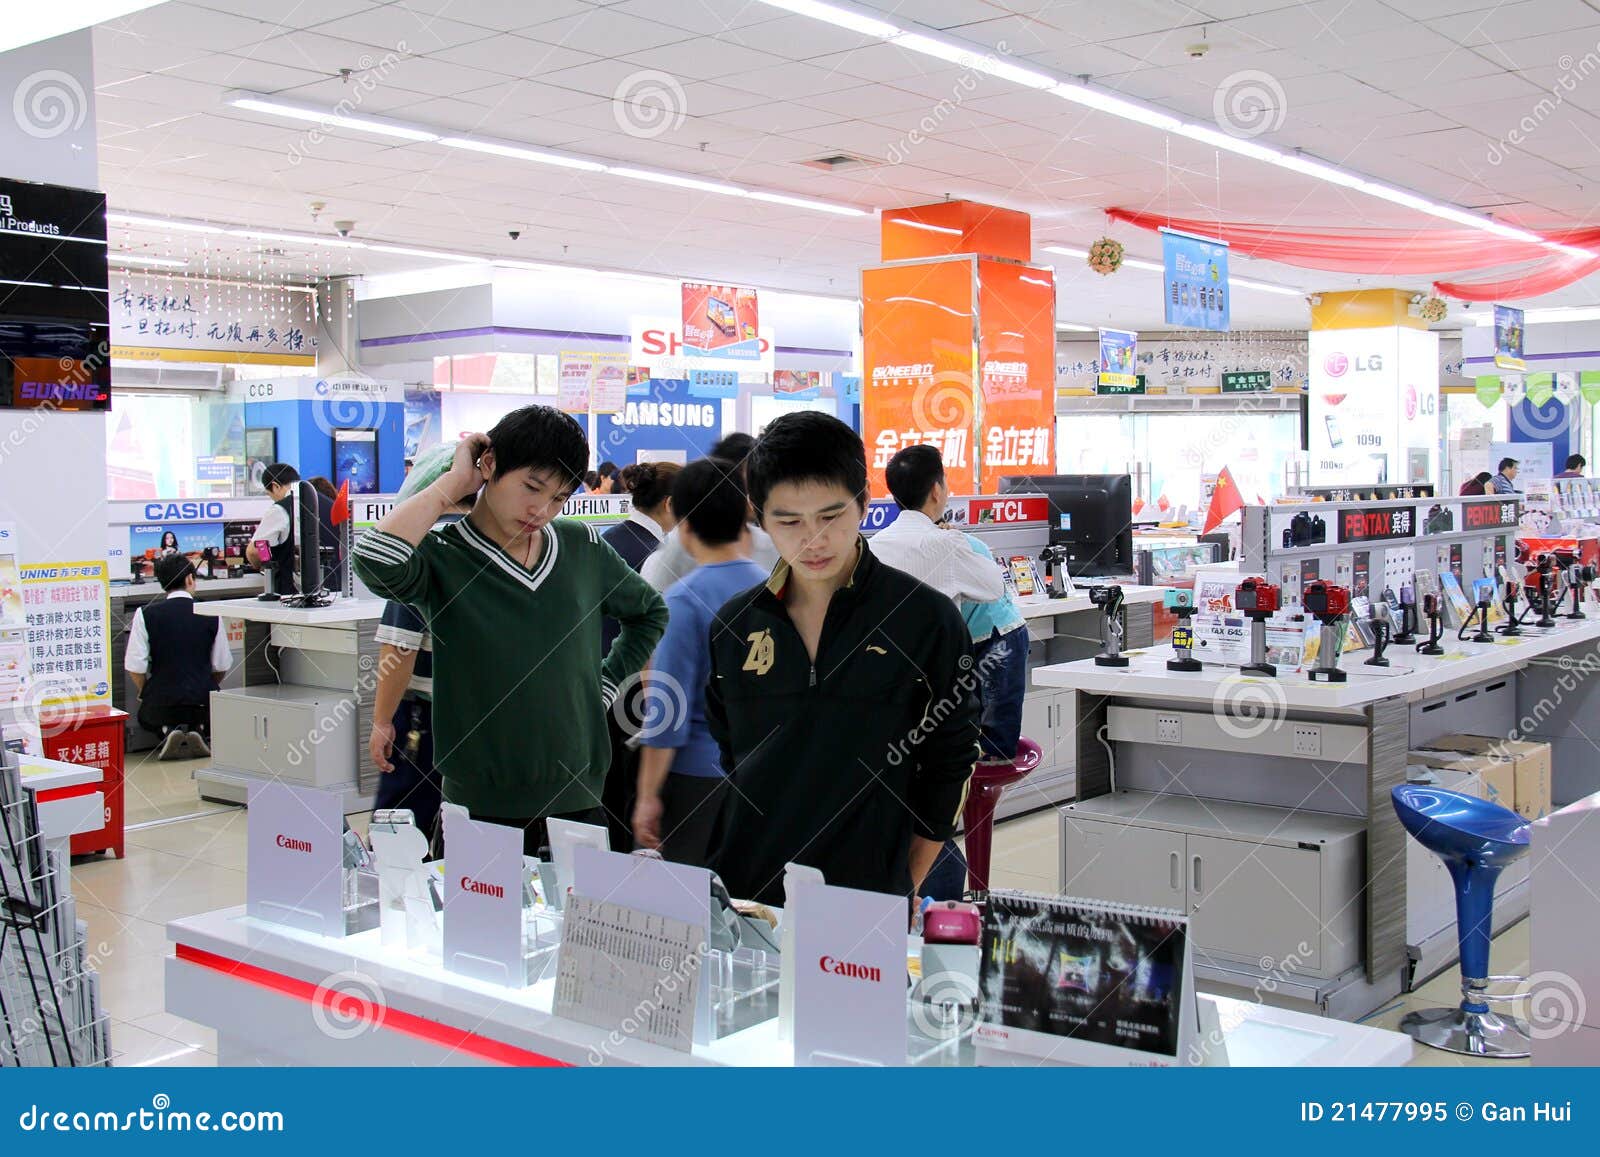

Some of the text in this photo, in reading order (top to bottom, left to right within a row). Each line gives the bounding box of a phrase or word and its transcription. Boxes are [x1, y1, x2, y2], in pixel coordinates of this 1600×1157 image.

[8, 217, 60, 234] Products
[1355, 354, 1383, 371] LG
[20, 381, 100, 401] SUNING
[249, 383, 274, 397] CCB
[1420, 393, 1435, 416] LG
[985, 425, 1050, 467] 金立手机
[145, 502, 224, 520] CASIO
[993, 501, 1028, 521] TCL
[1466, 503, 1516, 527] PENTAX 宾得
[1345, 511, 1410, 538] PENTAX 宾得
[57, 741, 110, 762] 灭火器箱
[276, 834, 312, 853] Canon
[461, 876, 504, 898] Canon
[819, 955, 881, 982] Canon
[976, 1025, 1010, 1040] Canon
